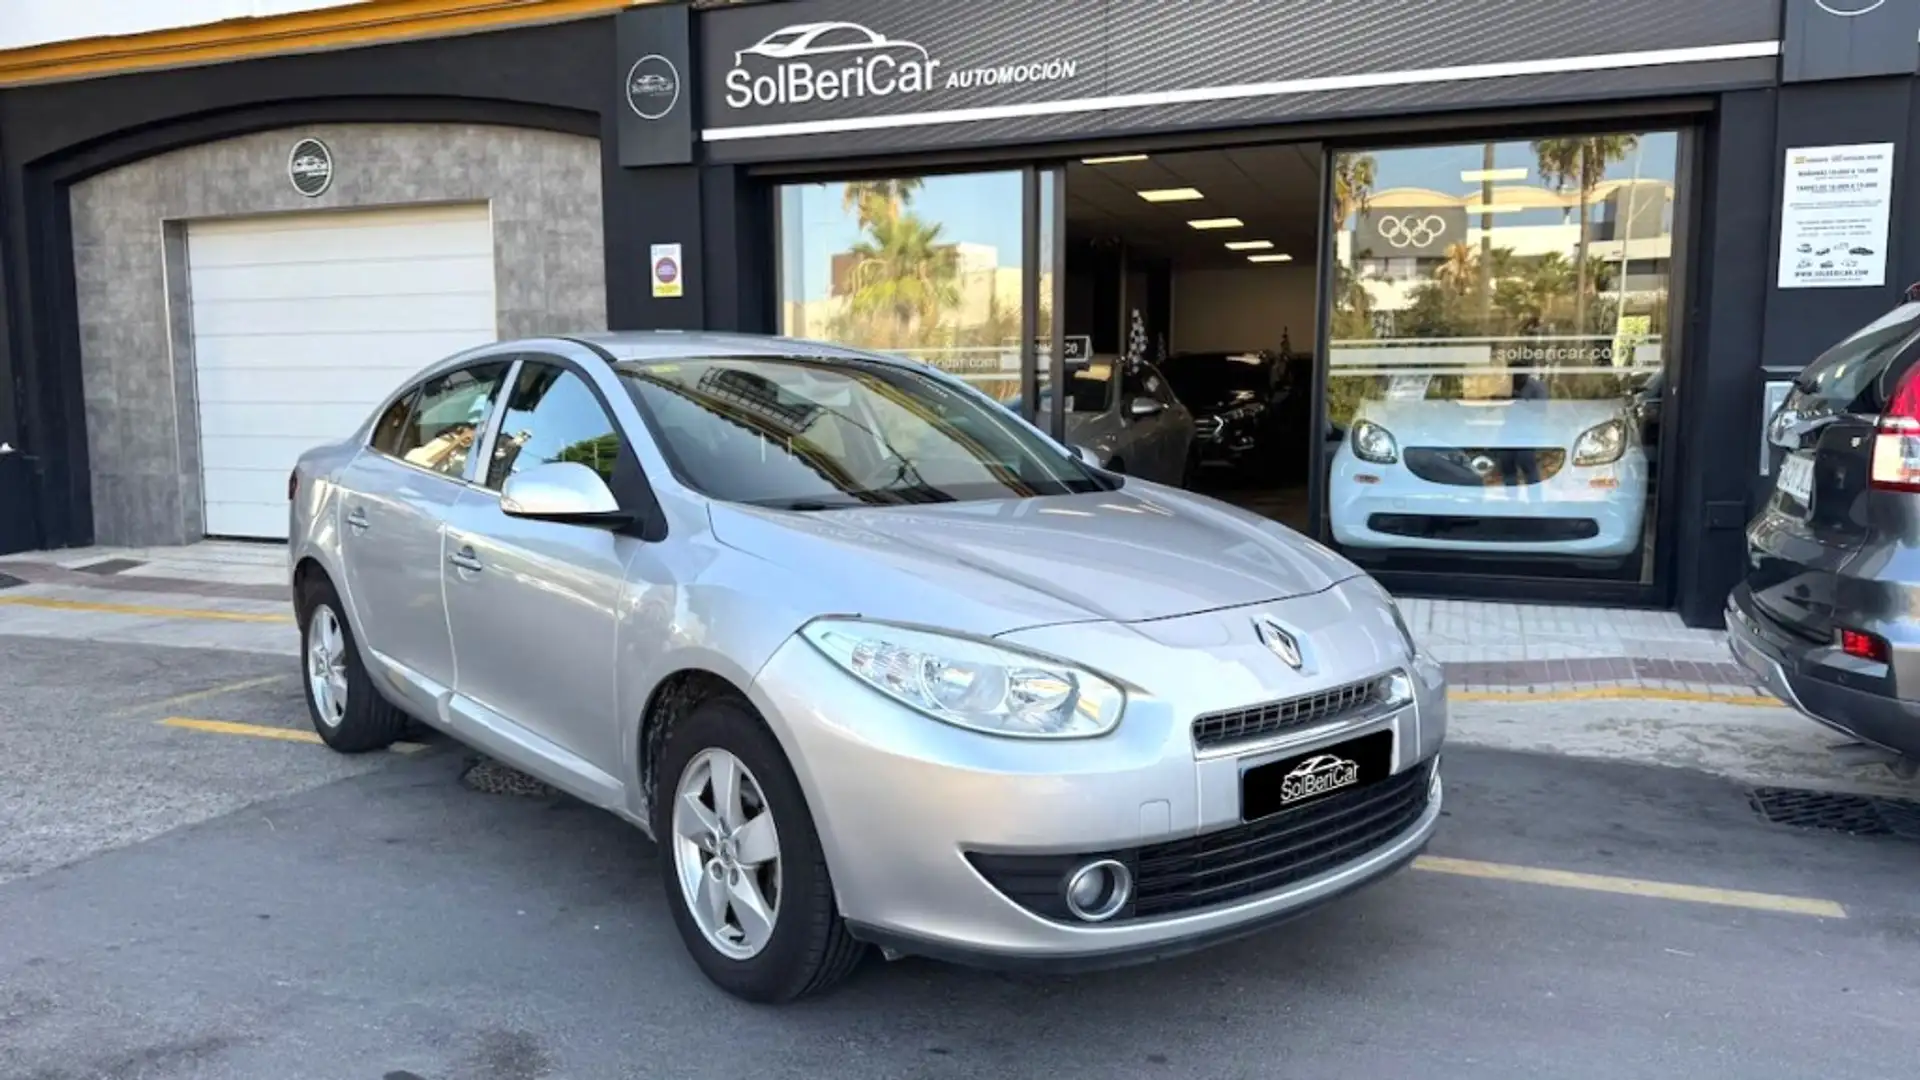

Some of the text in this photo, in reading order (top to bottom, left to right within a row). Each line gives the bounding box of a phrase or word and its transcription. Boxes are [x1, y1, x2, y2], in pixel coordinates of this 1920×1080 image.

[725, 54, 1076, 108] SolBeriCar AUTOMOCIÓN
[1280, 764, 1360, 800] SolBeriCar
